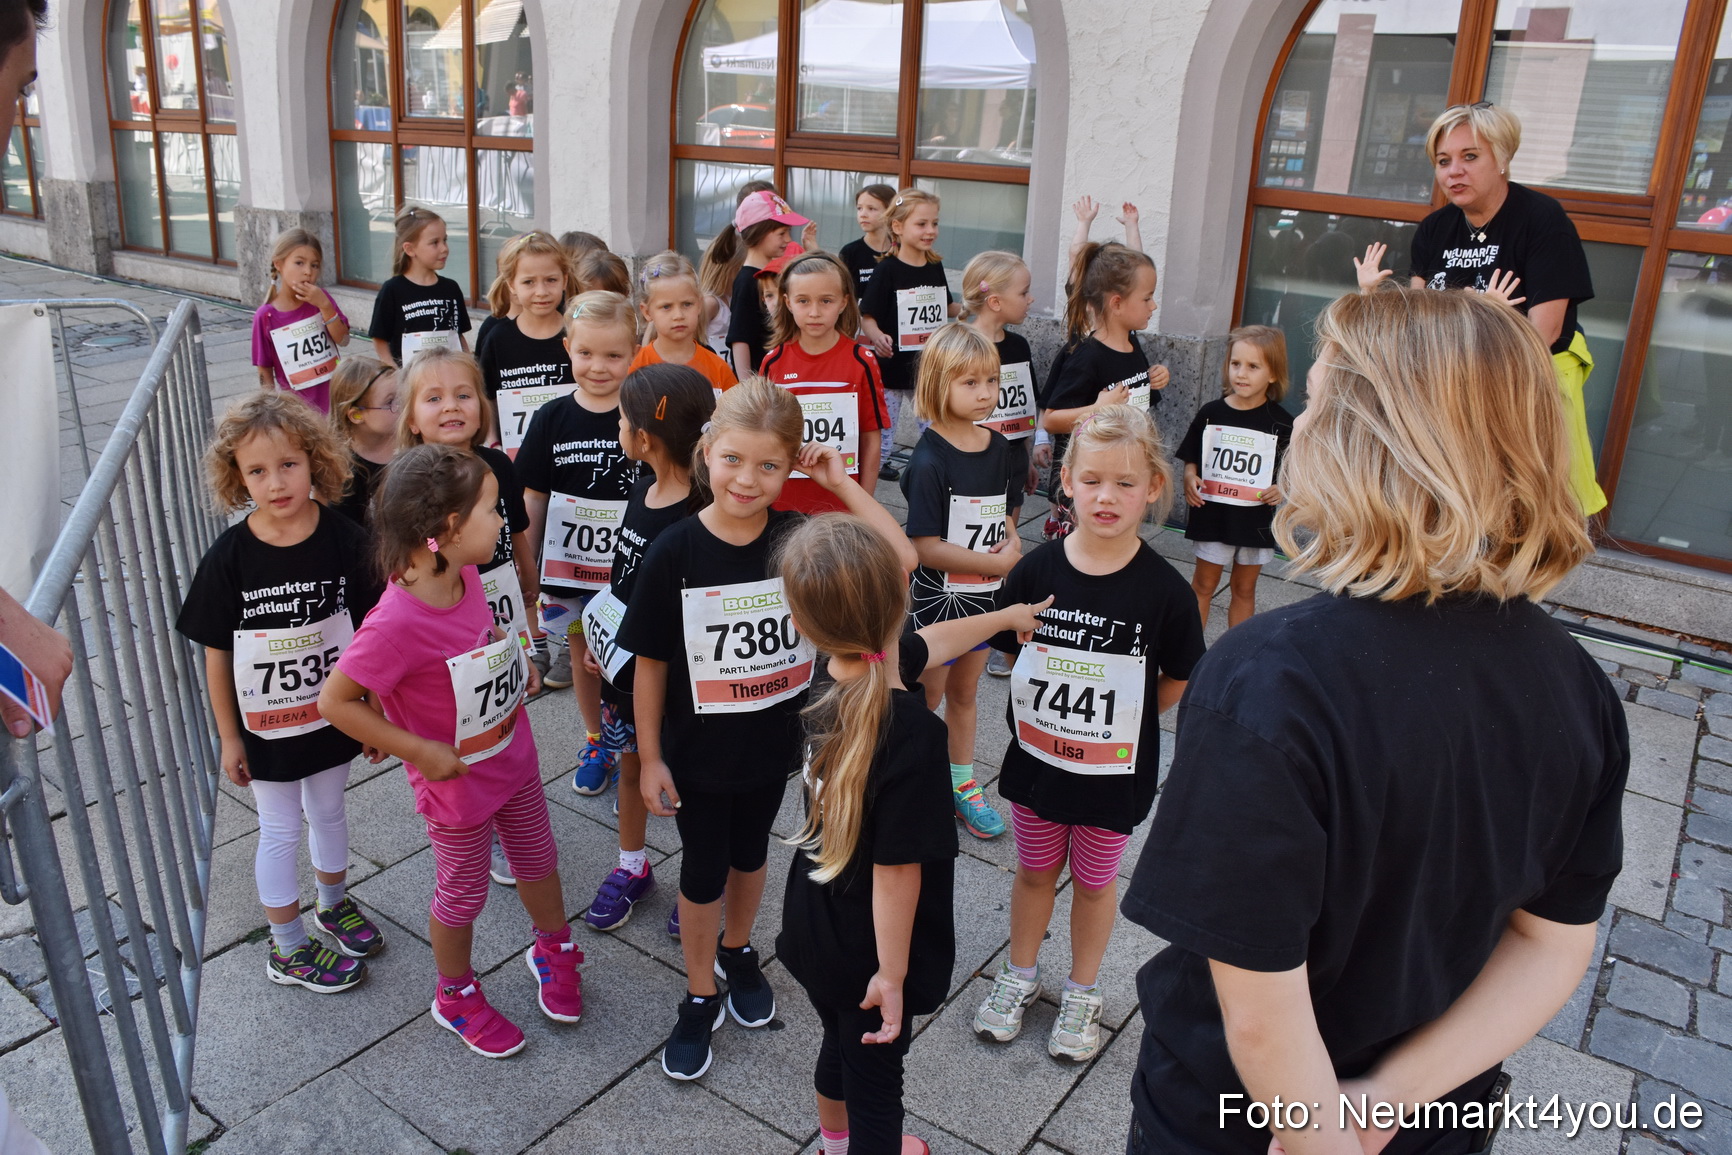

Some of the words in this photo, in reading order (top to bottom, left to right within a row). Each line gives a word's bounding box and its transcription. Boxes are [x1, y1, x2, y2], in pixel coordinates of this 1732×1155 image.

[401, 299, 444, 312] Neumarkter
[908, 304, 942, 325] 7432
[291, 321, 320, 337] BOCK
[287, 331, 331, 362] 7452
[421, 336, 448, 345] BOCK
[314, 365, 328, 376] Lea
[500, 363, 557, 378] Neumarkter
[501, 374, 546, 389] Stadtlauf
[997, 384, 1027, 409] 025
[1133, 393, 1150, 405] BOC
[802, 417, 846, 443] 094
[1000, 422, 1020, 432] Anna
[552, 438, 619, 455] Neumarkter
[1221, 433, 1255, 447] BOCK
[1212, 447, 1262, 476] 7050
[1218, 484, 1239, 496] Lara
[575, 506, 618, 519] BOCK
[980, 502, 1006, 515] BOC
[564, 552, 584, 561] PARTL
[585, 556, 614, 564] Neumarkt
[573, 566, 610, 581] Emma
[241, 581, 317, 602] eumarkter
[243, 598, 301, 619] tadtlauf
[723, 591, 783, 612] BOCK
[269, 631, 324, 651] BOCK
[706, 613, 801, 662] 7380
[694, 655, 704, 663] B5
[719, 665, 749, 675] PARTL
[750, 658, 786, 672] Neumarkt
[1047, 656, 1105, 677] BOCK
[253, 645, 340, 695] 7535
[729, 676, 789, 699] Theresa
[267, 697, 295, 706] PARTL
[1028, 677, 1116, 726] 7441
[260, 710, 308, 728] HELENA
[462, 717, 471, 725] B1
[483, 712, 504, 728] PARTL
[1035, 717, 1059, 732] PARTL
[1060, 725, 1099, 738] Neumarkt
[1053, 739, 1084, 760] Lisa
